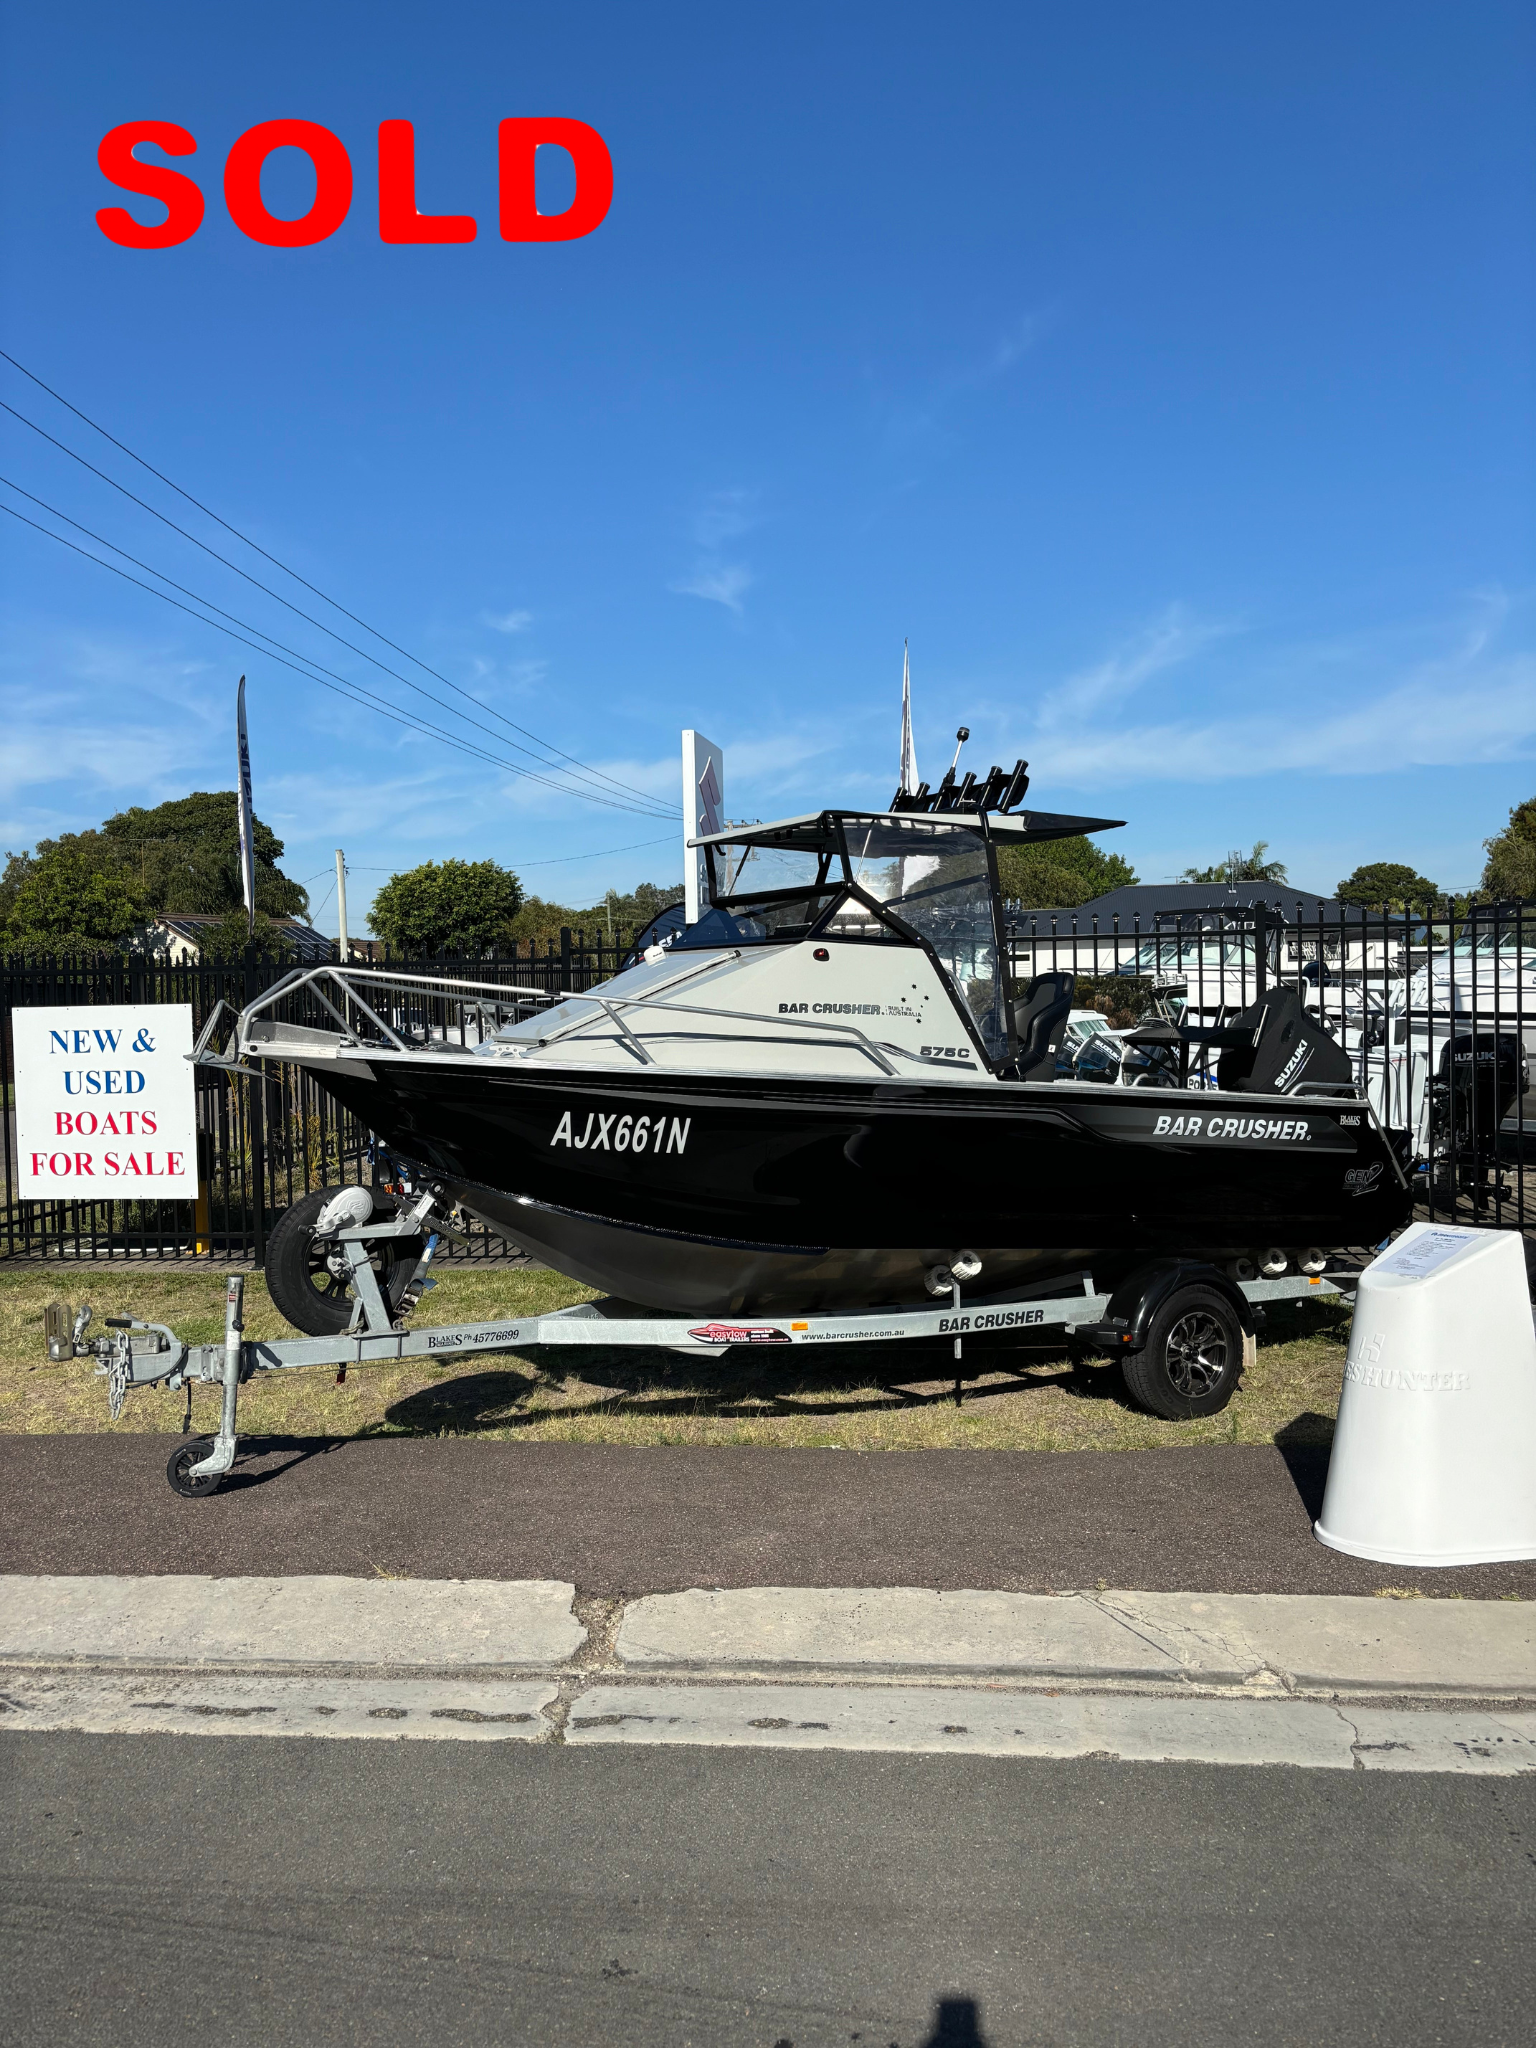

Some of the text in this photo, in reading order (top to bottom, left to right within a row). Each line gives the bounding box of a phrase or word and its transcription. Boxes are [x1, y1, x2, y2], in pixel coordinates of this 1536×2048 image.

[778, 1003, 809, 1014] BAR
[48, 1028, 157, 1054] NEW &
[919, 1046, 970, 1059] 575C
[1274, 1039, 1309, 1088] SUZUKI
[63, 1070, 146, 1095] USED
[54, 1110, 158, 1136] BOATS
[1153, 1115, 1203, 1136] BAR
[1340, 1115, 1361, 1126] BLAKES
[550, 1111, 691, 1154] AJX661N
[30, 1152, 186, 1176] FOR SALE
[939, 1309, 1044, 1332] BAR CRUSHER
[428, 1333, 463, 1348] BLAKES
[463, 1333, 472, 1341] Ph
[473, 1329, 519, 1344] 45776699
[709, 1330, 748, 1340] easytow
[801, 1330, 905, 1341] www.barcrusher.com.au
